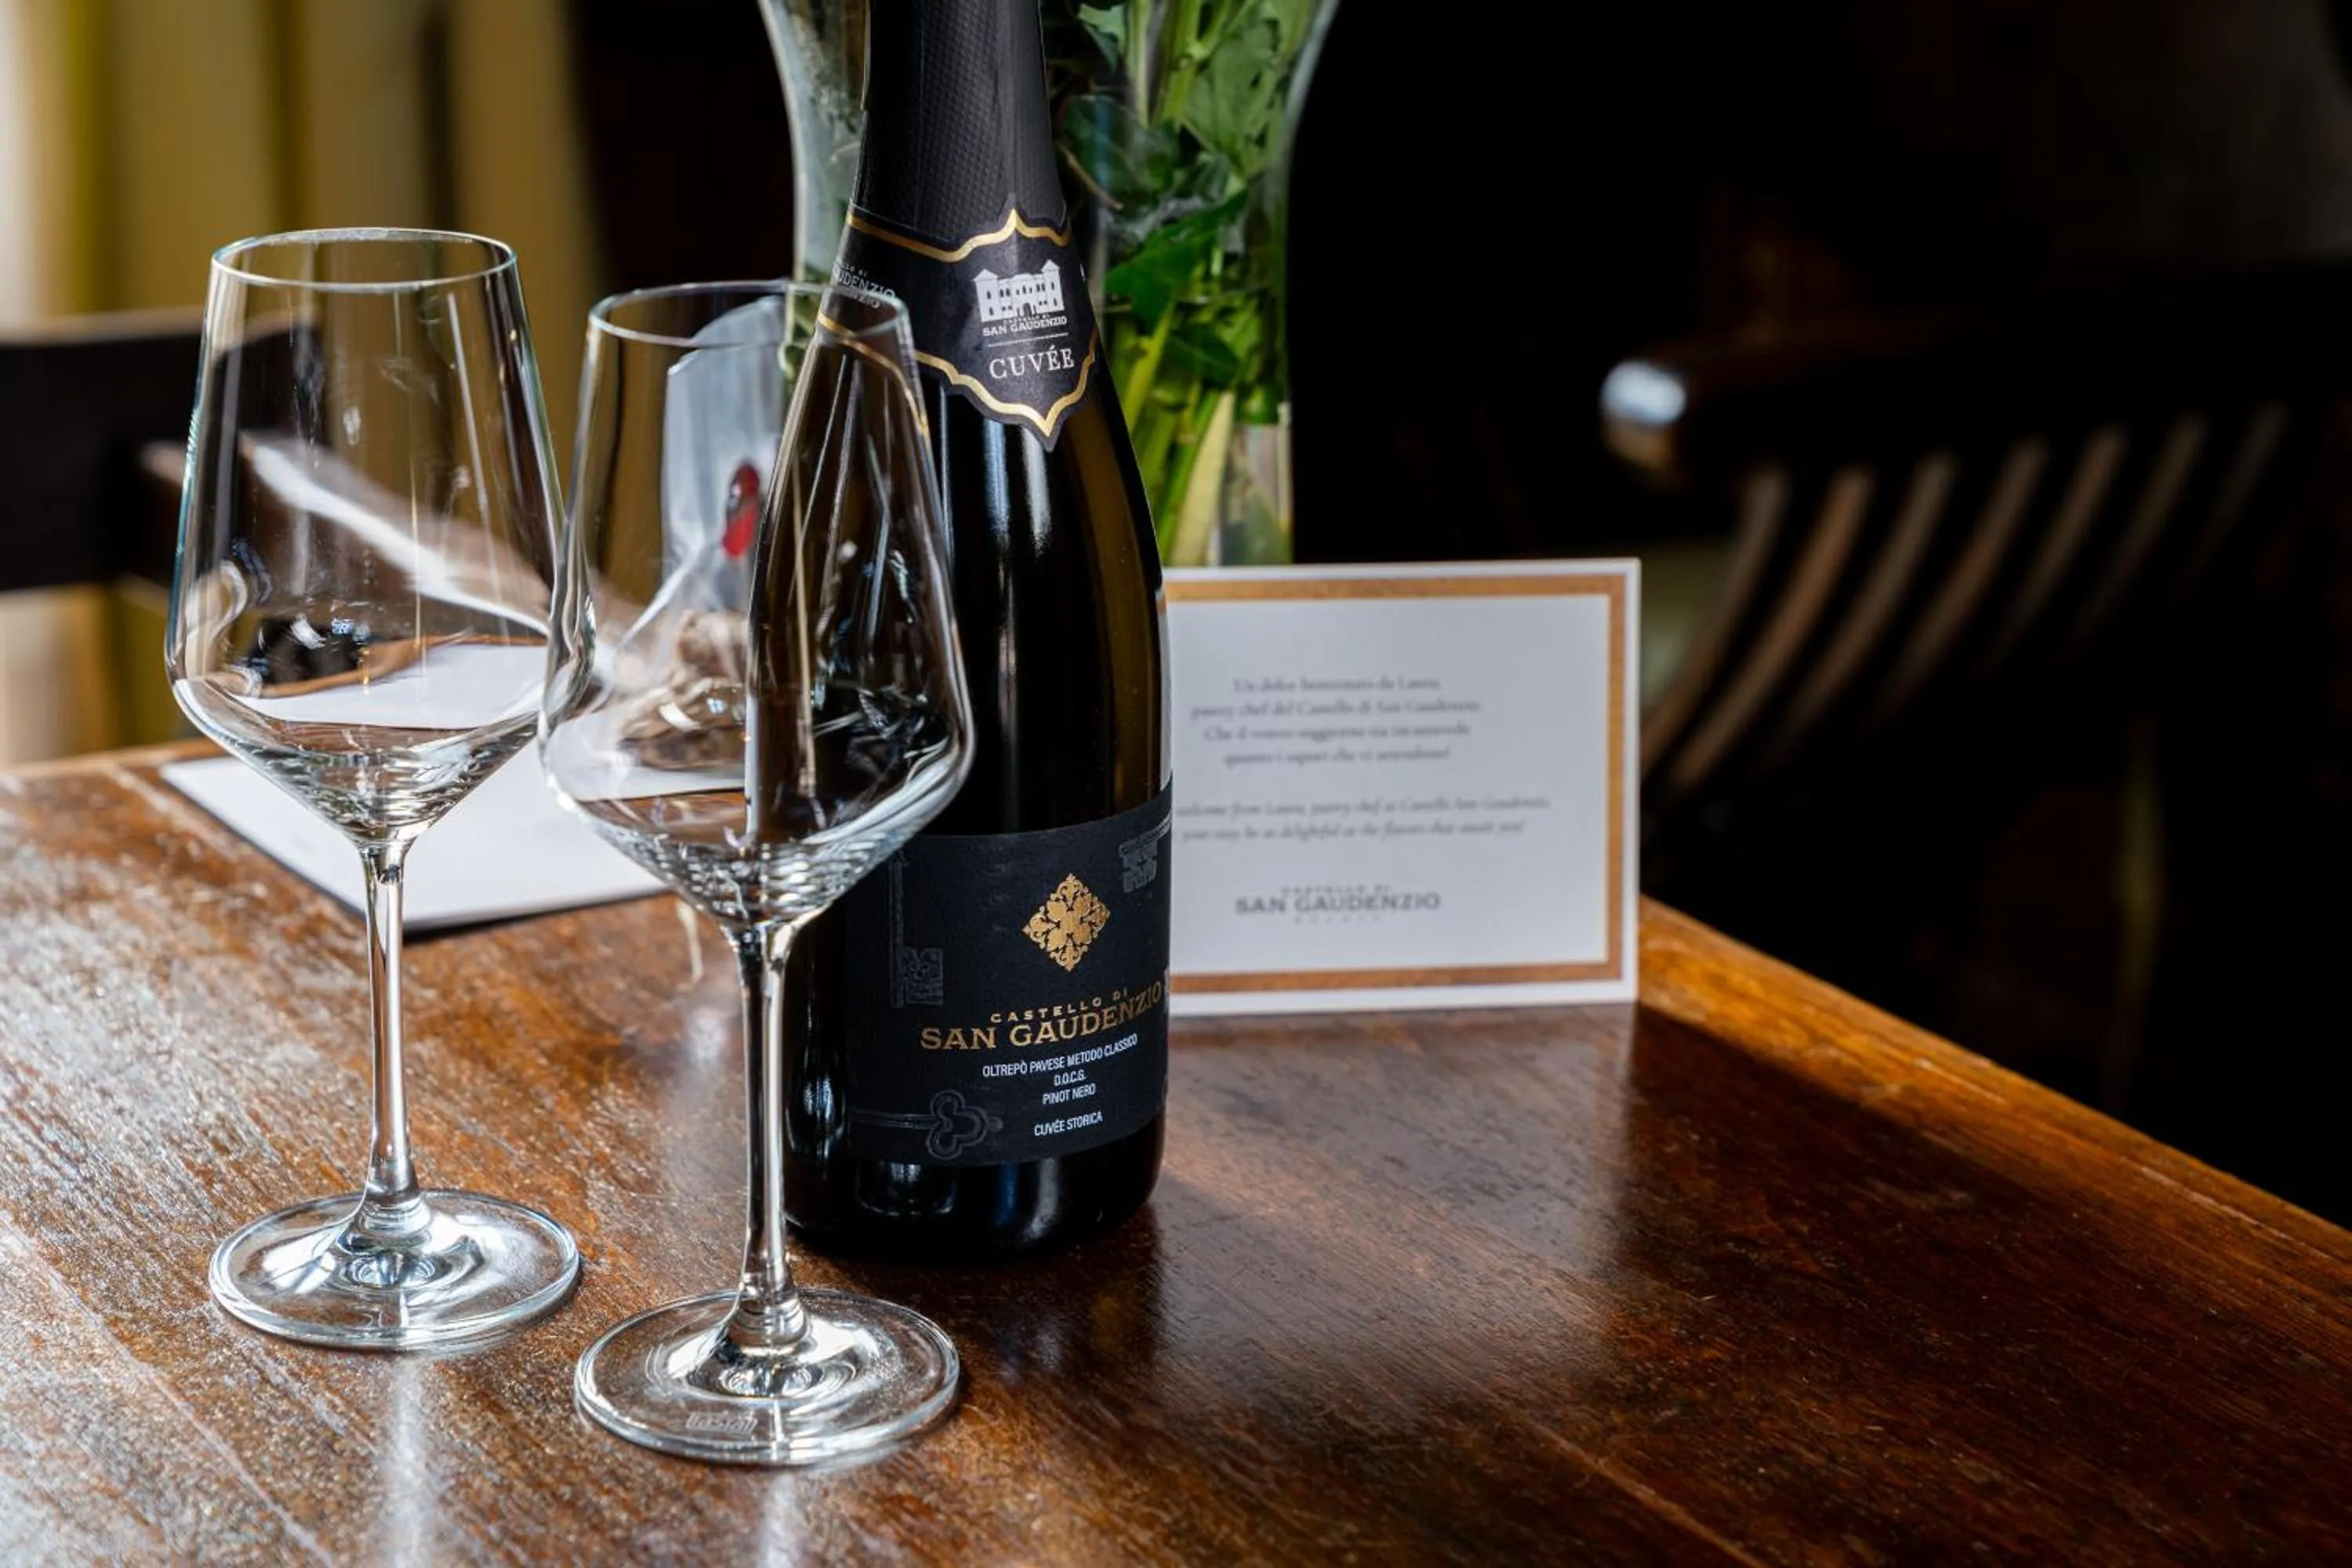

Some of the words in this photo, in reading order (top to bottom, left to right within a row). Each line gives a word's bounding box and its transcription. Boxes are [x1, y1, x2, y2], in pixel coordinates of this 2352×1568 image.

[982, 325, 1007, 336] SAN
[989, 345, 1074, 379] CUVÉE
[1234, 897, 1287, 915] SAN
[1294, 891, 1443, 913] GAUDENZIO
[920, 1026, 996, 1051] SAN
[1009, 980, 1162, 1047] GAUDENZIO
[990, 996, 1102, 1023] CASTELLO
[1112, 986, 1127, 1000] DI
[982, 1059, 1028, 1078] OLTREPÒ
[1029, 1056, 1065, 1073] PAVESE
[1067, 1046, 1103, 1067] METODO
[1103, 1033, 1138, 1056] CLASSICO
[1042, 1088, 1070, 1105] PINOT
[1072, 1083, 1096, 1099] NERO
[1034, 1119, 1066, 1137] CUVÉE
[1066, 1110, 1103, 1131] STORICA
